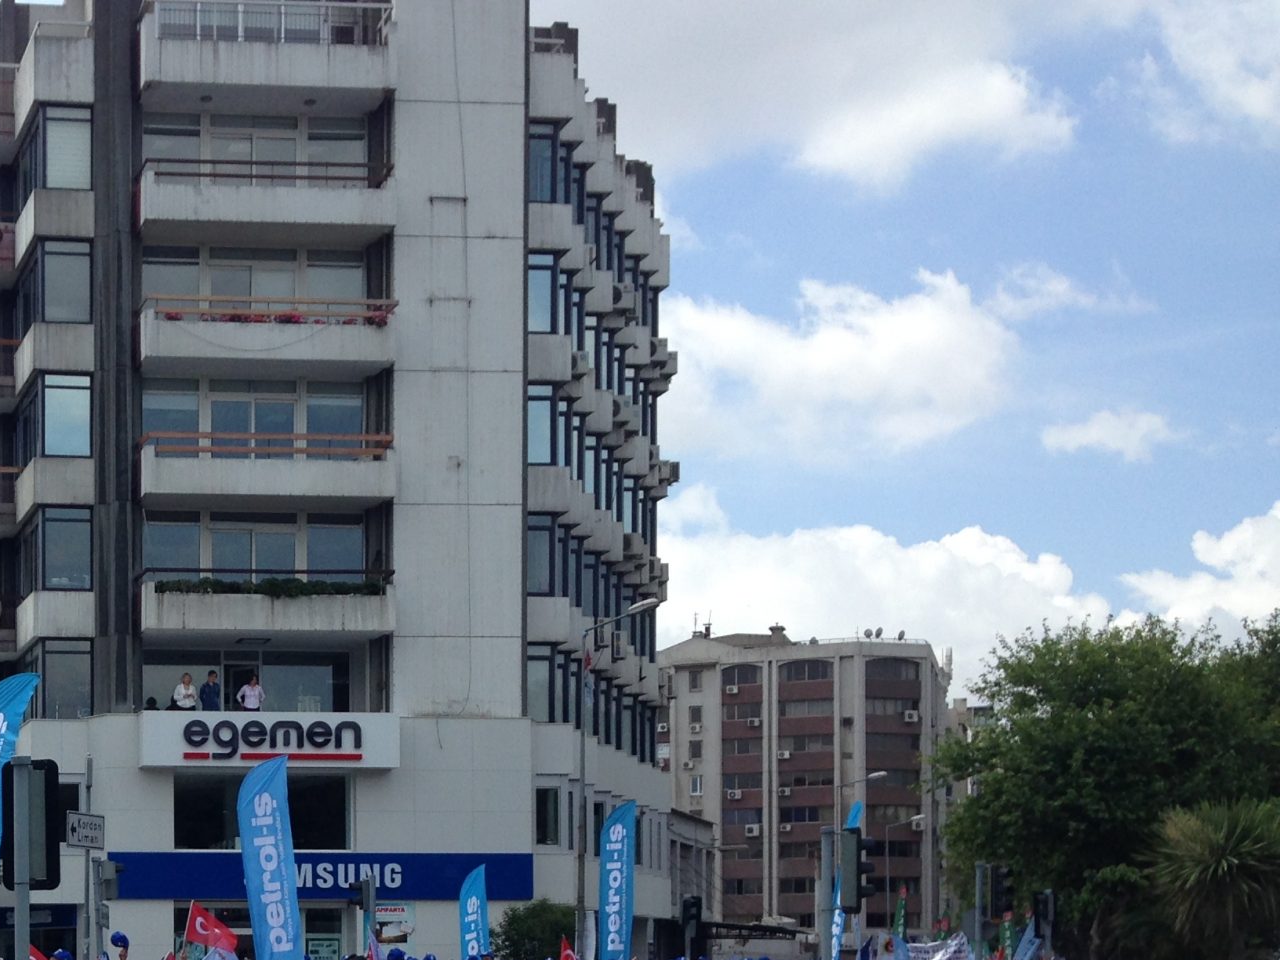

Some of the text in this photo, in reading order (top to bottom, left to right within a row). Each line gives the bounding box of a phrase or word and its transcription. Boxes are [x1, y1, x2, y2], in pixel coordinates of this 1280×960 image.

[183, 719, 362, 760] egemen
[252, 791, 293, 953] petrol-iş
[292, 863, 402, 888] MSUNG
[465, 896, 480, 956] ol-iş
